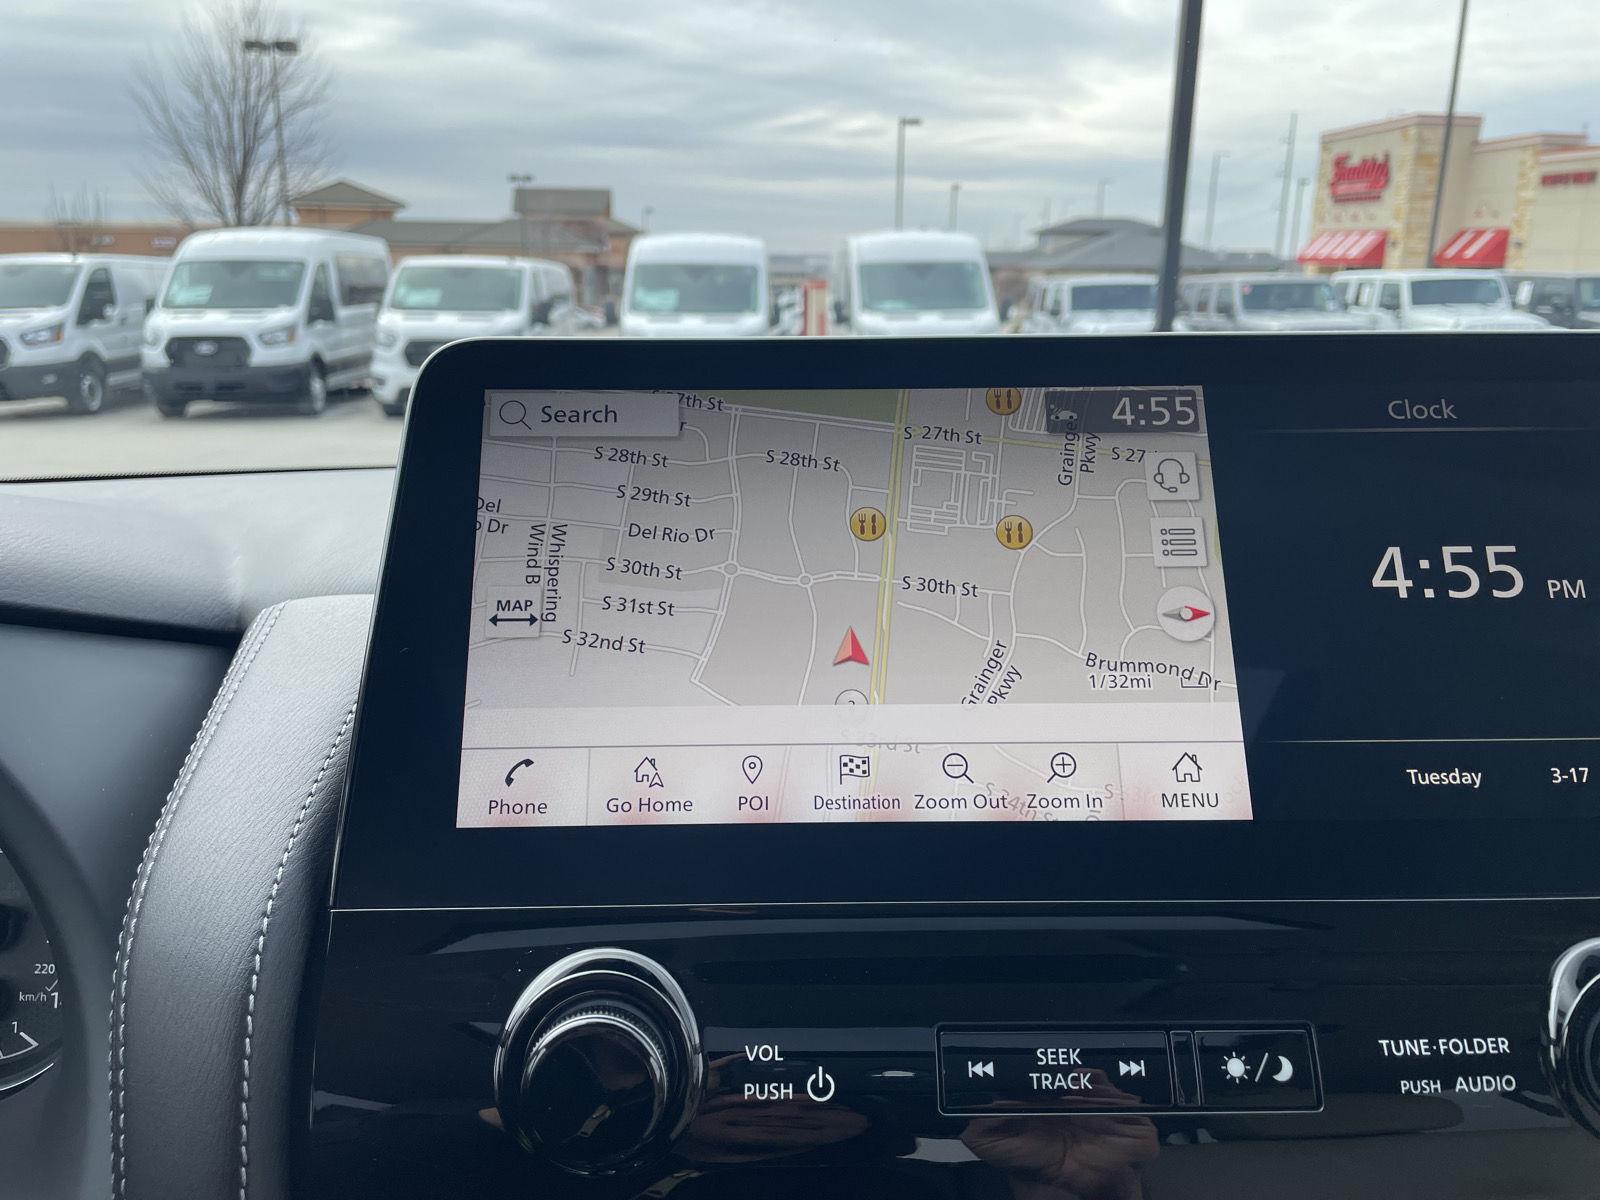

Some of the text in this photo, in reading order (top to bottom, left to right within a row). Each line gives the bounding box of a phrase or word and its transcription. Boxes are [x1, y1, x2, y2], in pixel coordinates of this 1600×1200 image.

[667, 391, 724, 411] 7th St
[1111, 396, 1196, 426] 4:55
[1387, 399, 1457, 420] Clock
[540, 404, 618, 424] Search
[903, 426, 982, 445] S 27th St
[594, 446, 669, 468] S 28th St
[765, 450, 841, 472] S 28th St
[1057, 420, 1102, 486] Grainge Pkwy
[1111, 446, 1146, 463] S 27
[616, 484, 692, 508] S 29th St
[487, 518, 509, 534] Dr
[628, 523, 716, 543] Del Rio Dr
[526, 523, 547, 569] Wind
[540, 524, 569, 622] Whispering
[605, 557, 683, 581] S 30th St
[1371, 546, 1587, 599] 4:55 PM
[902, 576, 979, 597] S 30th St
[496, 599, 534, 612] MAP
[601, 596, 675, 617] S 31st St
[562, 629, 646, 654] S 32nd St
[1085, 652, 1222, 691] Brummond Dr
[1089, 674, 1152, 689] 1/32mi
[987, 665, 1022, 705] Pkwy
[1406, 767, 1590, 788] Tuesday 3-17
[488, 799, 548, 815] Phone
[606, 797, 693, 813] Go Home
[737, 796, 770, 811] POI
[814, 795, 901, 810] Destination
[914, 793, 1008, 809] Zoom Out
[1026, 793, 1103, 809] Zoom In
[1161, 793, 1219, 808] MENU
[34, 963, 56, 975] 220
[19, 991, 47, 1002] km/h
[744, 1044, 784, 1062] VOL
[1036, 1048, 1082, 1066] SEEK
[744, 1082, 793, 1100] PUSH
[1028, 1072, 1093, 1091] TRACK
[1400, 1074, 1517, 1095] PUSH AUDIO
